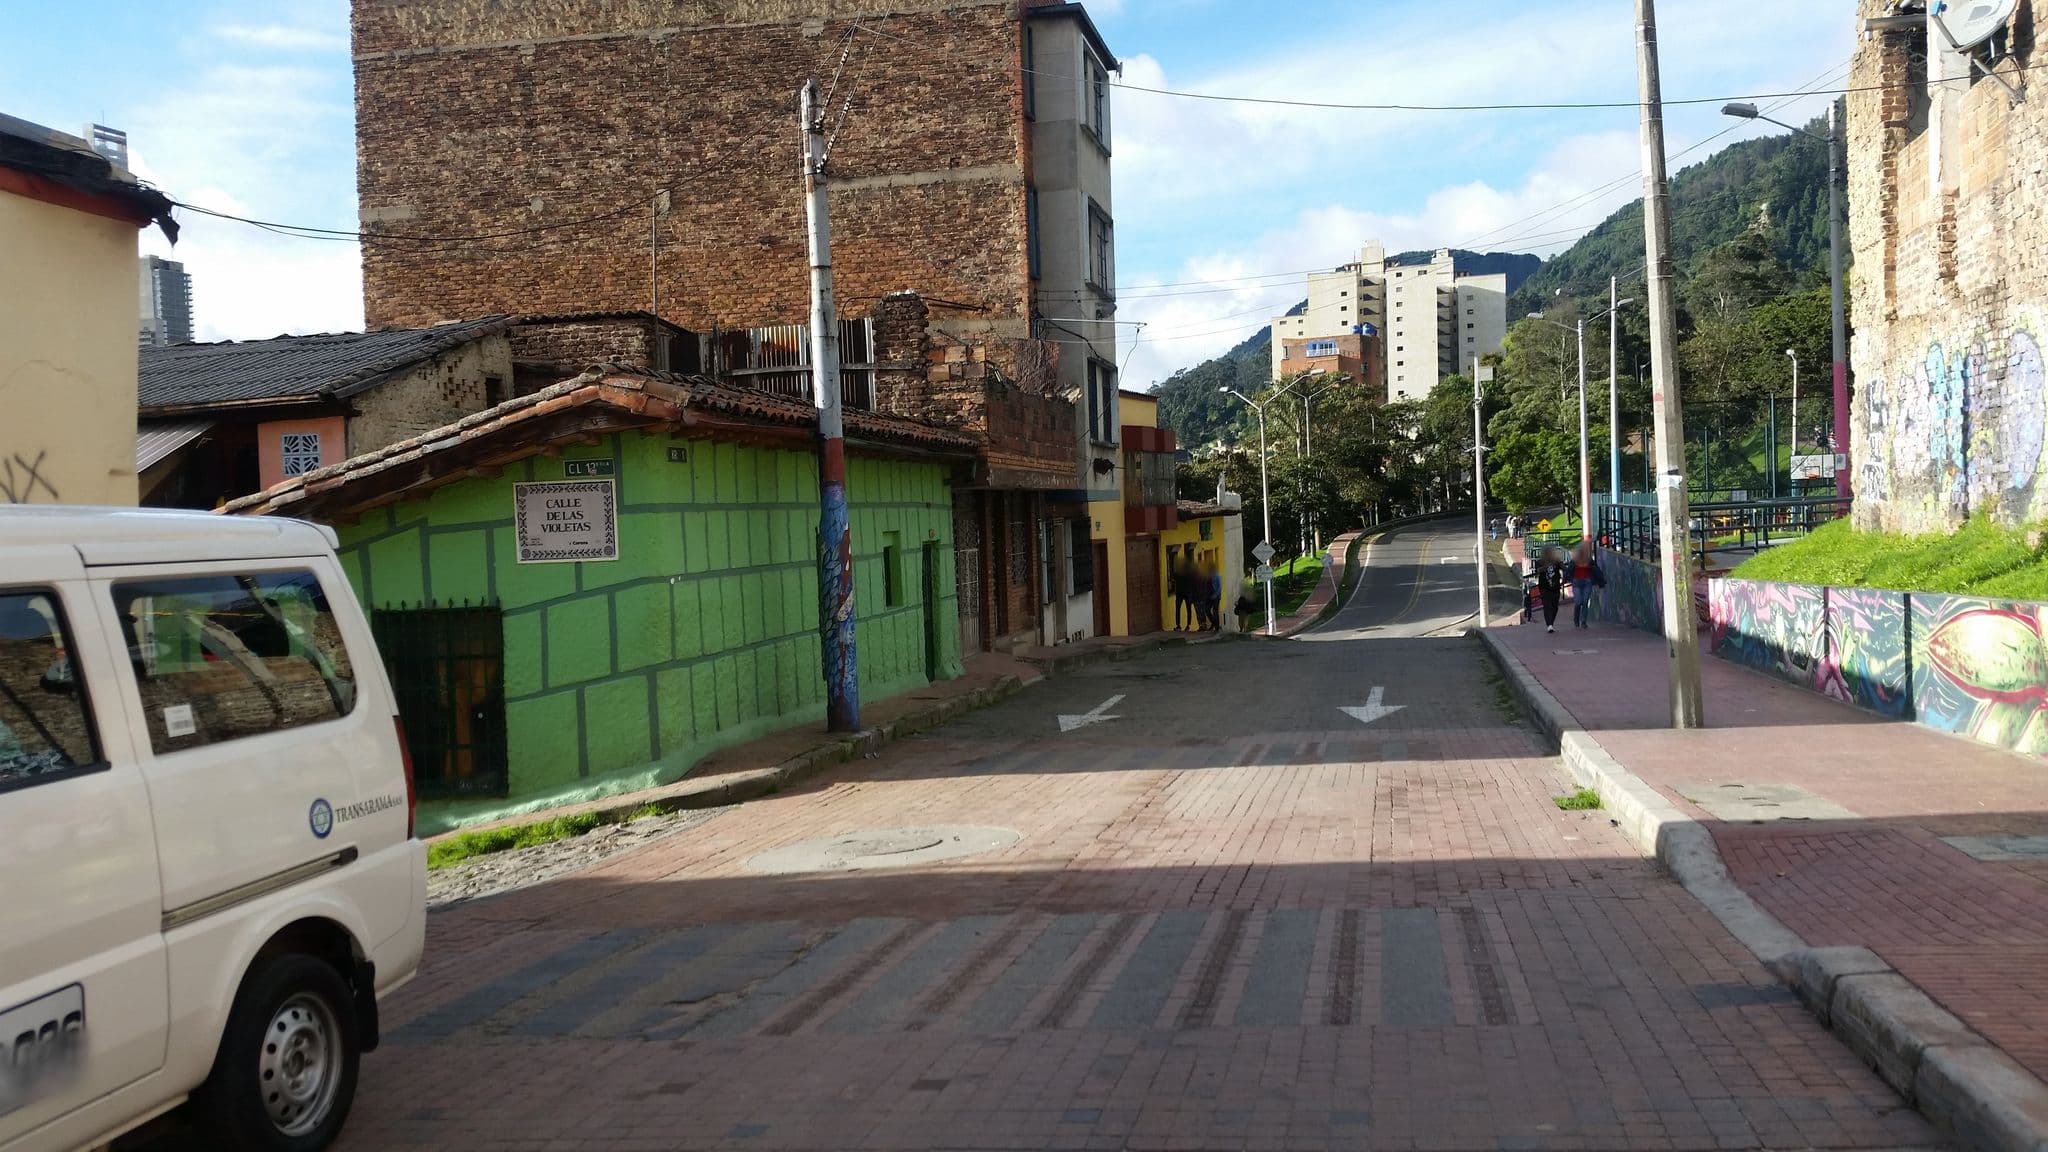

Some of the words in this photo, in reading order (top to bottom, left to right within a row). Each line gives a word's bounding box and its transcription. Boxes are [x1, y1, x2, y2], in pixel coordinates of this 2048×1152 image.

[568, 463, 582, 474] CL
[546, 498, 582, 509] CALLE
[546, 511, 561, 521] DE
[562, 510, 584, 521] LAS
[541, 522, 591, 533] VIOLETAS
